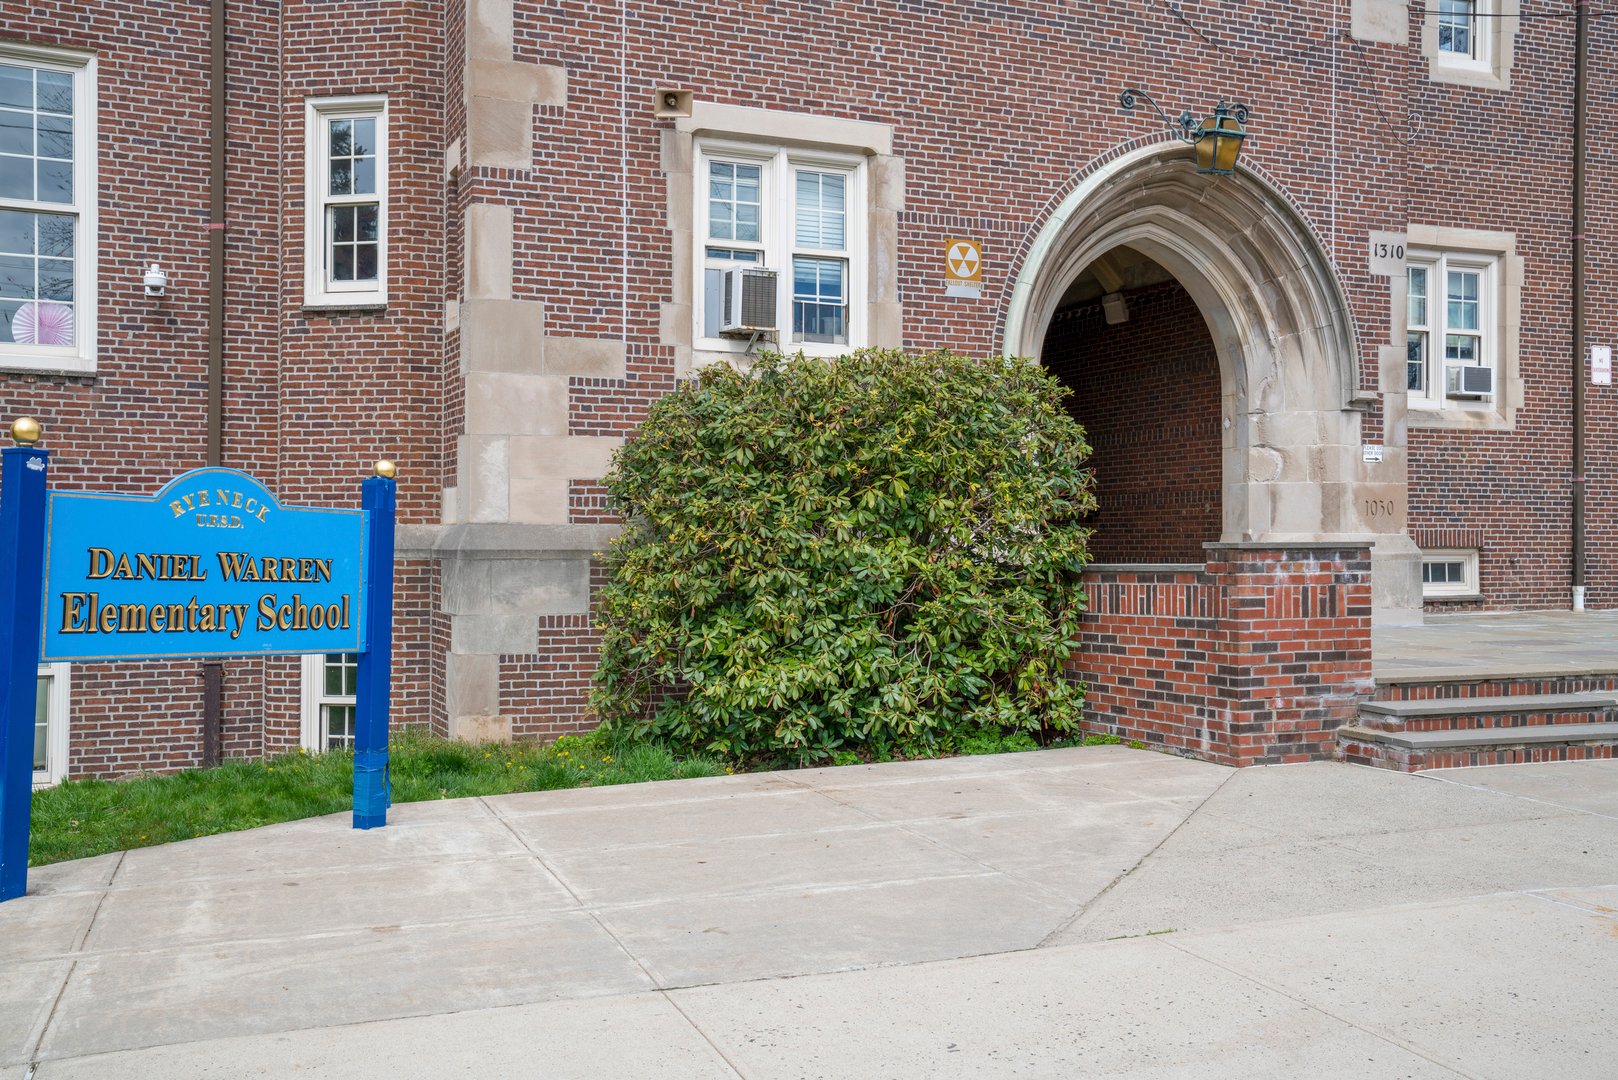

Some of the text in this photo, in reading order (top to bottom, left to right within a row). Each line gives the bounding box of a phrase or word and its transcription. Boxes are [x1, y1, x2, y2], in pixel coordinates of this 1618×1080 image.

[1374, 243, 1404, 260] 1310
[169, 489, 271, 523] RYE NECK
[196, 513, 245, 529] U.F.S.D.
[86, 547, 334, 583] DANIEL WARREN
[58, 591, 351, 640] Elementary School
